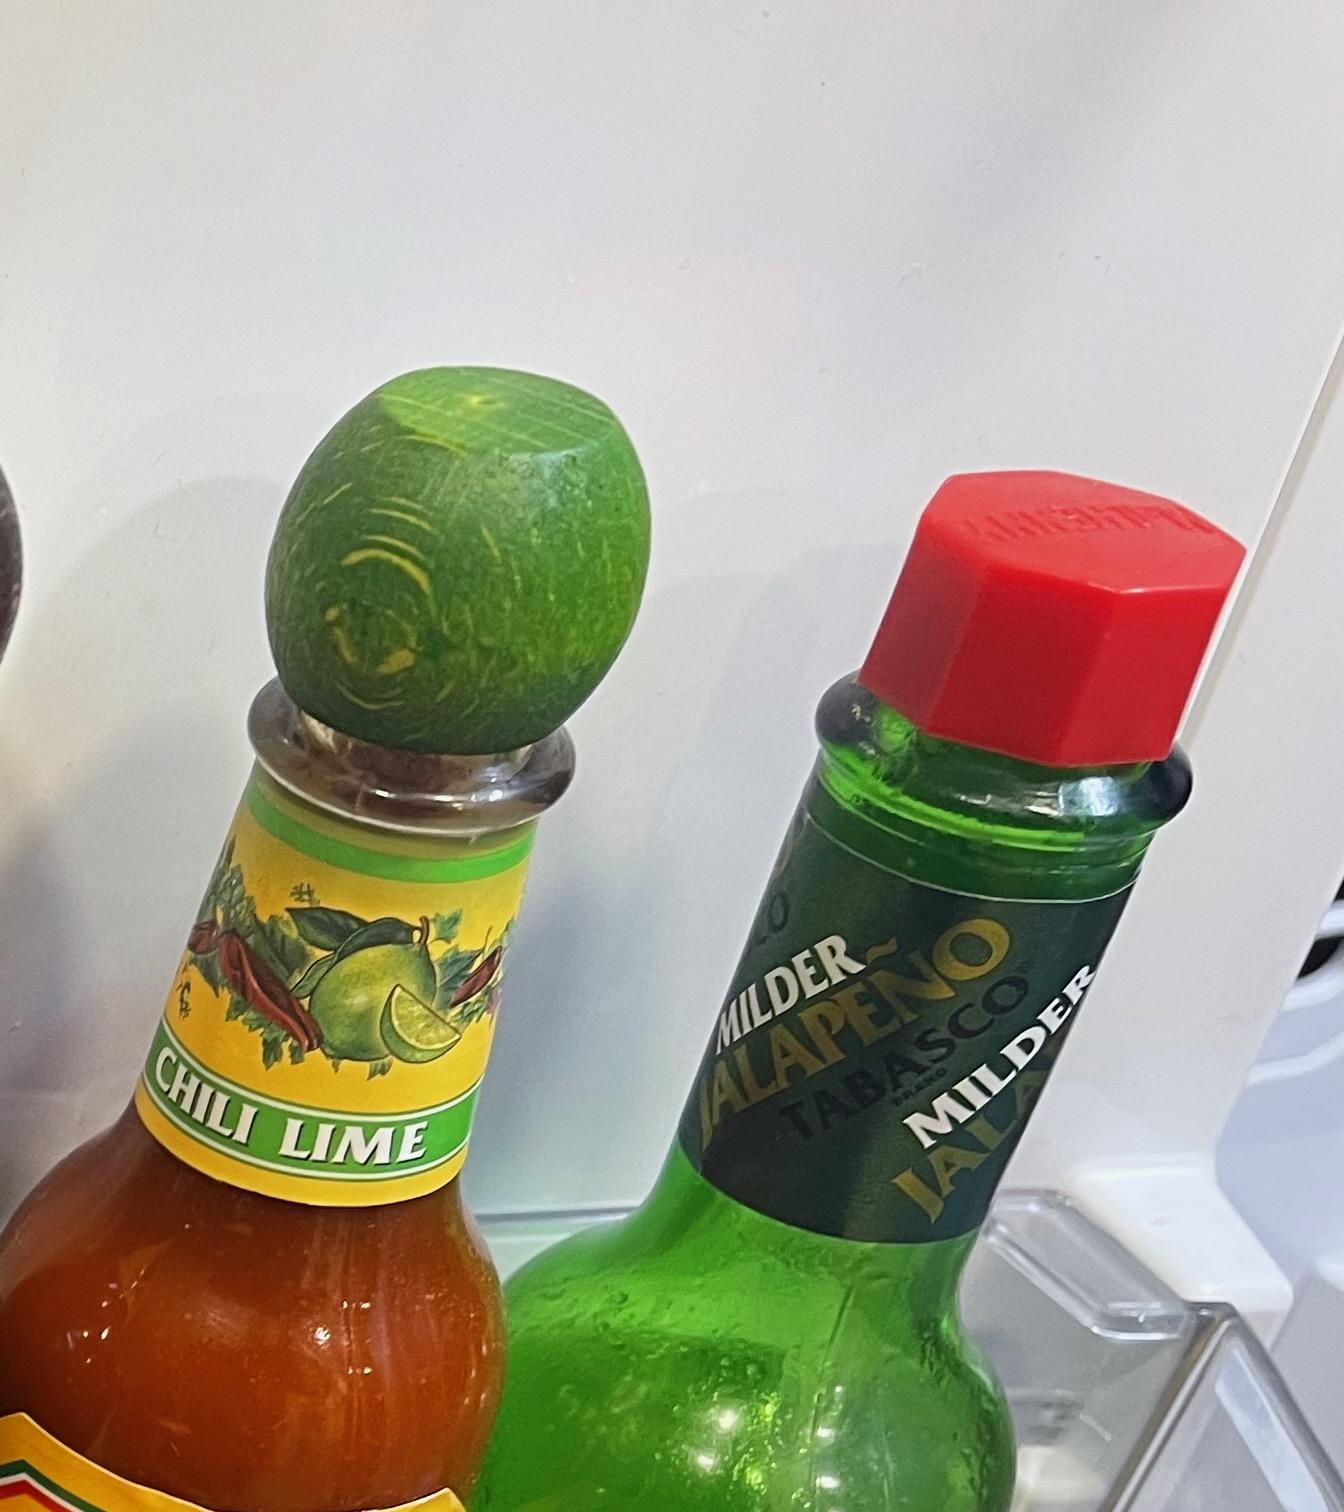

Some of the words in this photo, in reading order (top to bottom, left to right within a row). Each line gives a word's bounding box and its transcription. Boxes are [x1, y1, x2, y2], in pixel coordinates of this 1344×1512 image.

[698, 917, 1010, 1152] JALAPEÑO
[715, 934, 867, 1055] MILDER
[778, 975, 1031, 1140] TABASCO
[902, 964, 1096, 1150] MILDER
[155, 1047, 259, 1145] CHILI
[278, 1118, 429, 1165] LIME
